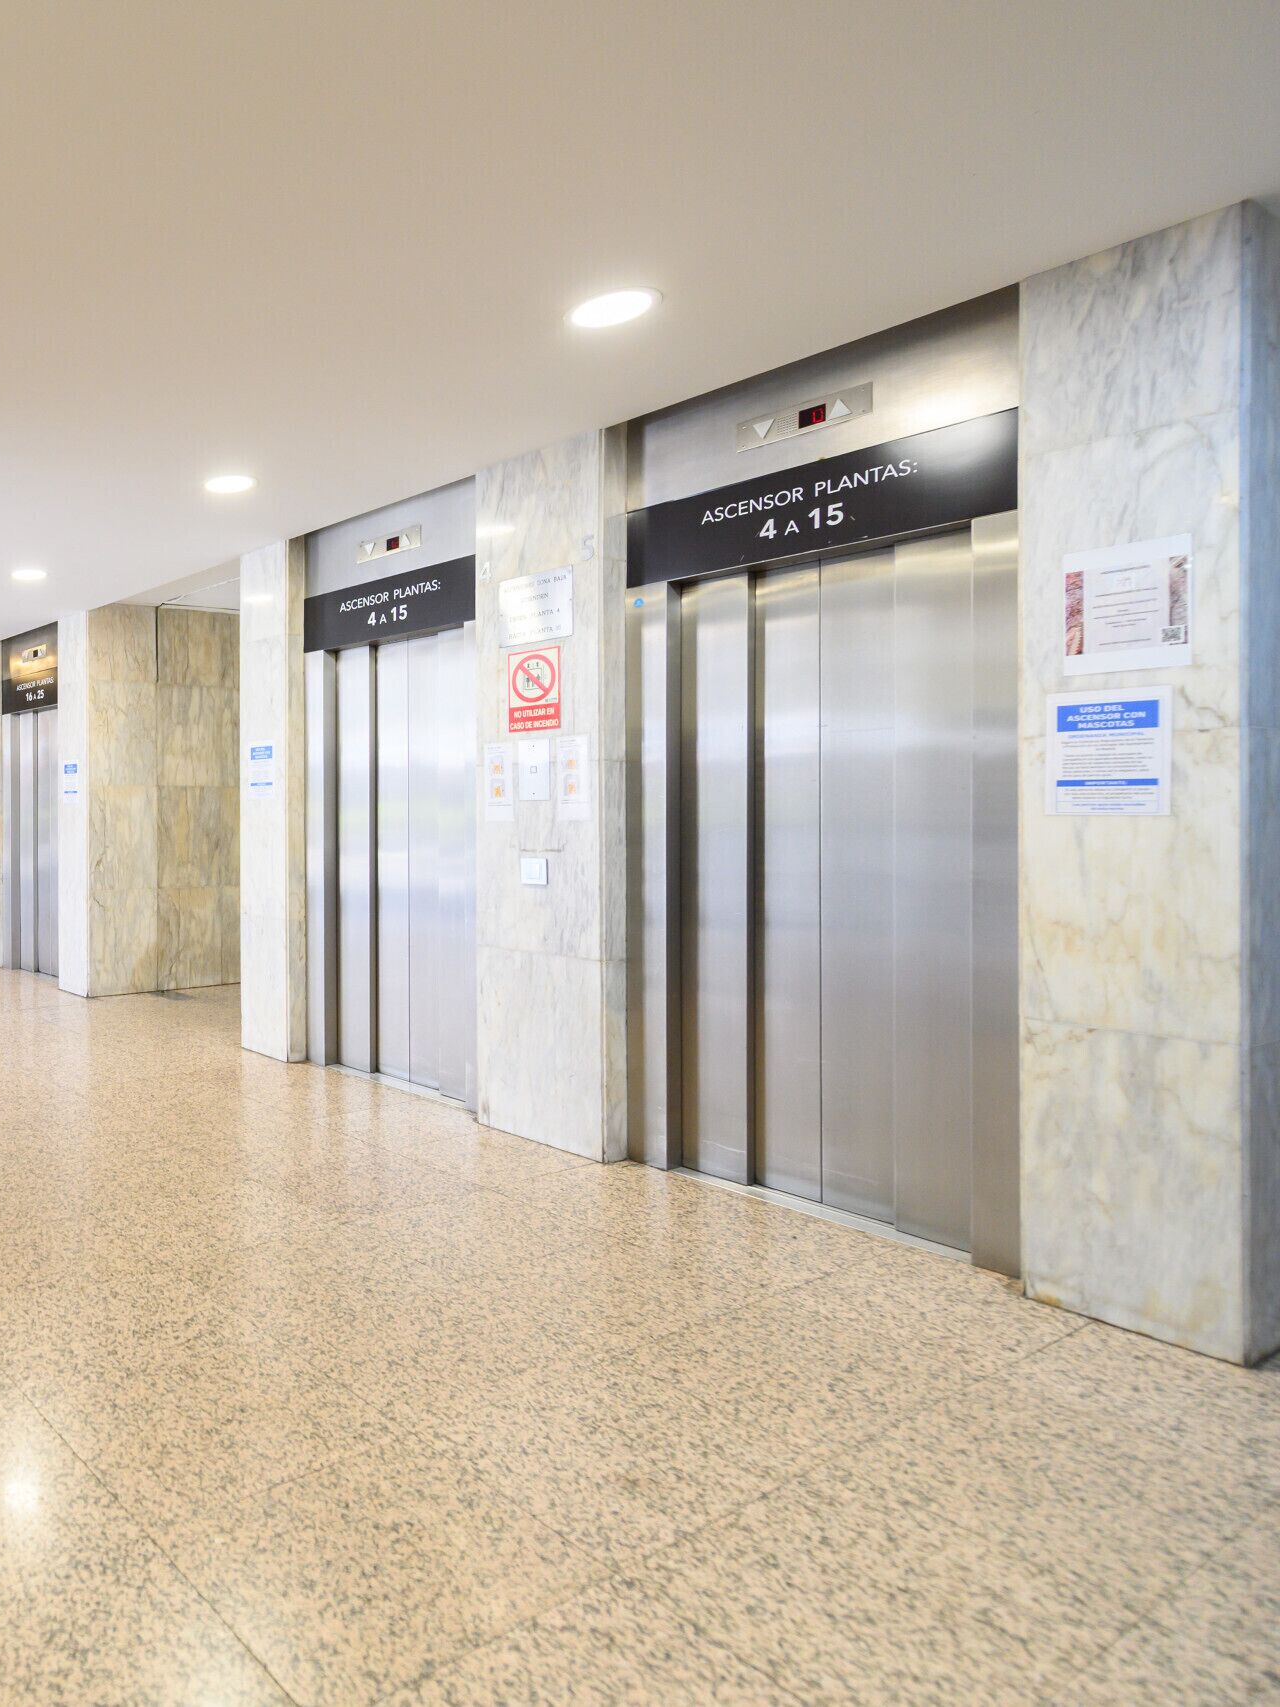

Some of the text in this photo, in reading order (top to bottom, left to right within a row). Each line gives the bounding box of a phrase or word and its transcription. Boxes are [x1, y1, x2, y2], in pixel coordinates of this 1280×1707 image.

[701, 459, 919, 525] ASCENSOR PLANTAS:
[759, 502, 845, 540] 4 A 15
[581, 534, 595, 562] 5
[339, 579, 441, 613] ASCENSOR PLANTAS:
[367, 604, 408, 626] 4 A 15
[25, 691, 33, 702] 16
[37, 689, 45, 700] 25
[513, 707, 555, 718] NO UTILIZAR EN
[1079, 704, 1125, 714] USO DEL
[1066, 711, 1147, 722] ASCENSOR CON
[510, 719, 559, 730] CASO DE INCENDIO
[1077, 720, 1136, 729] MASCOTAS
